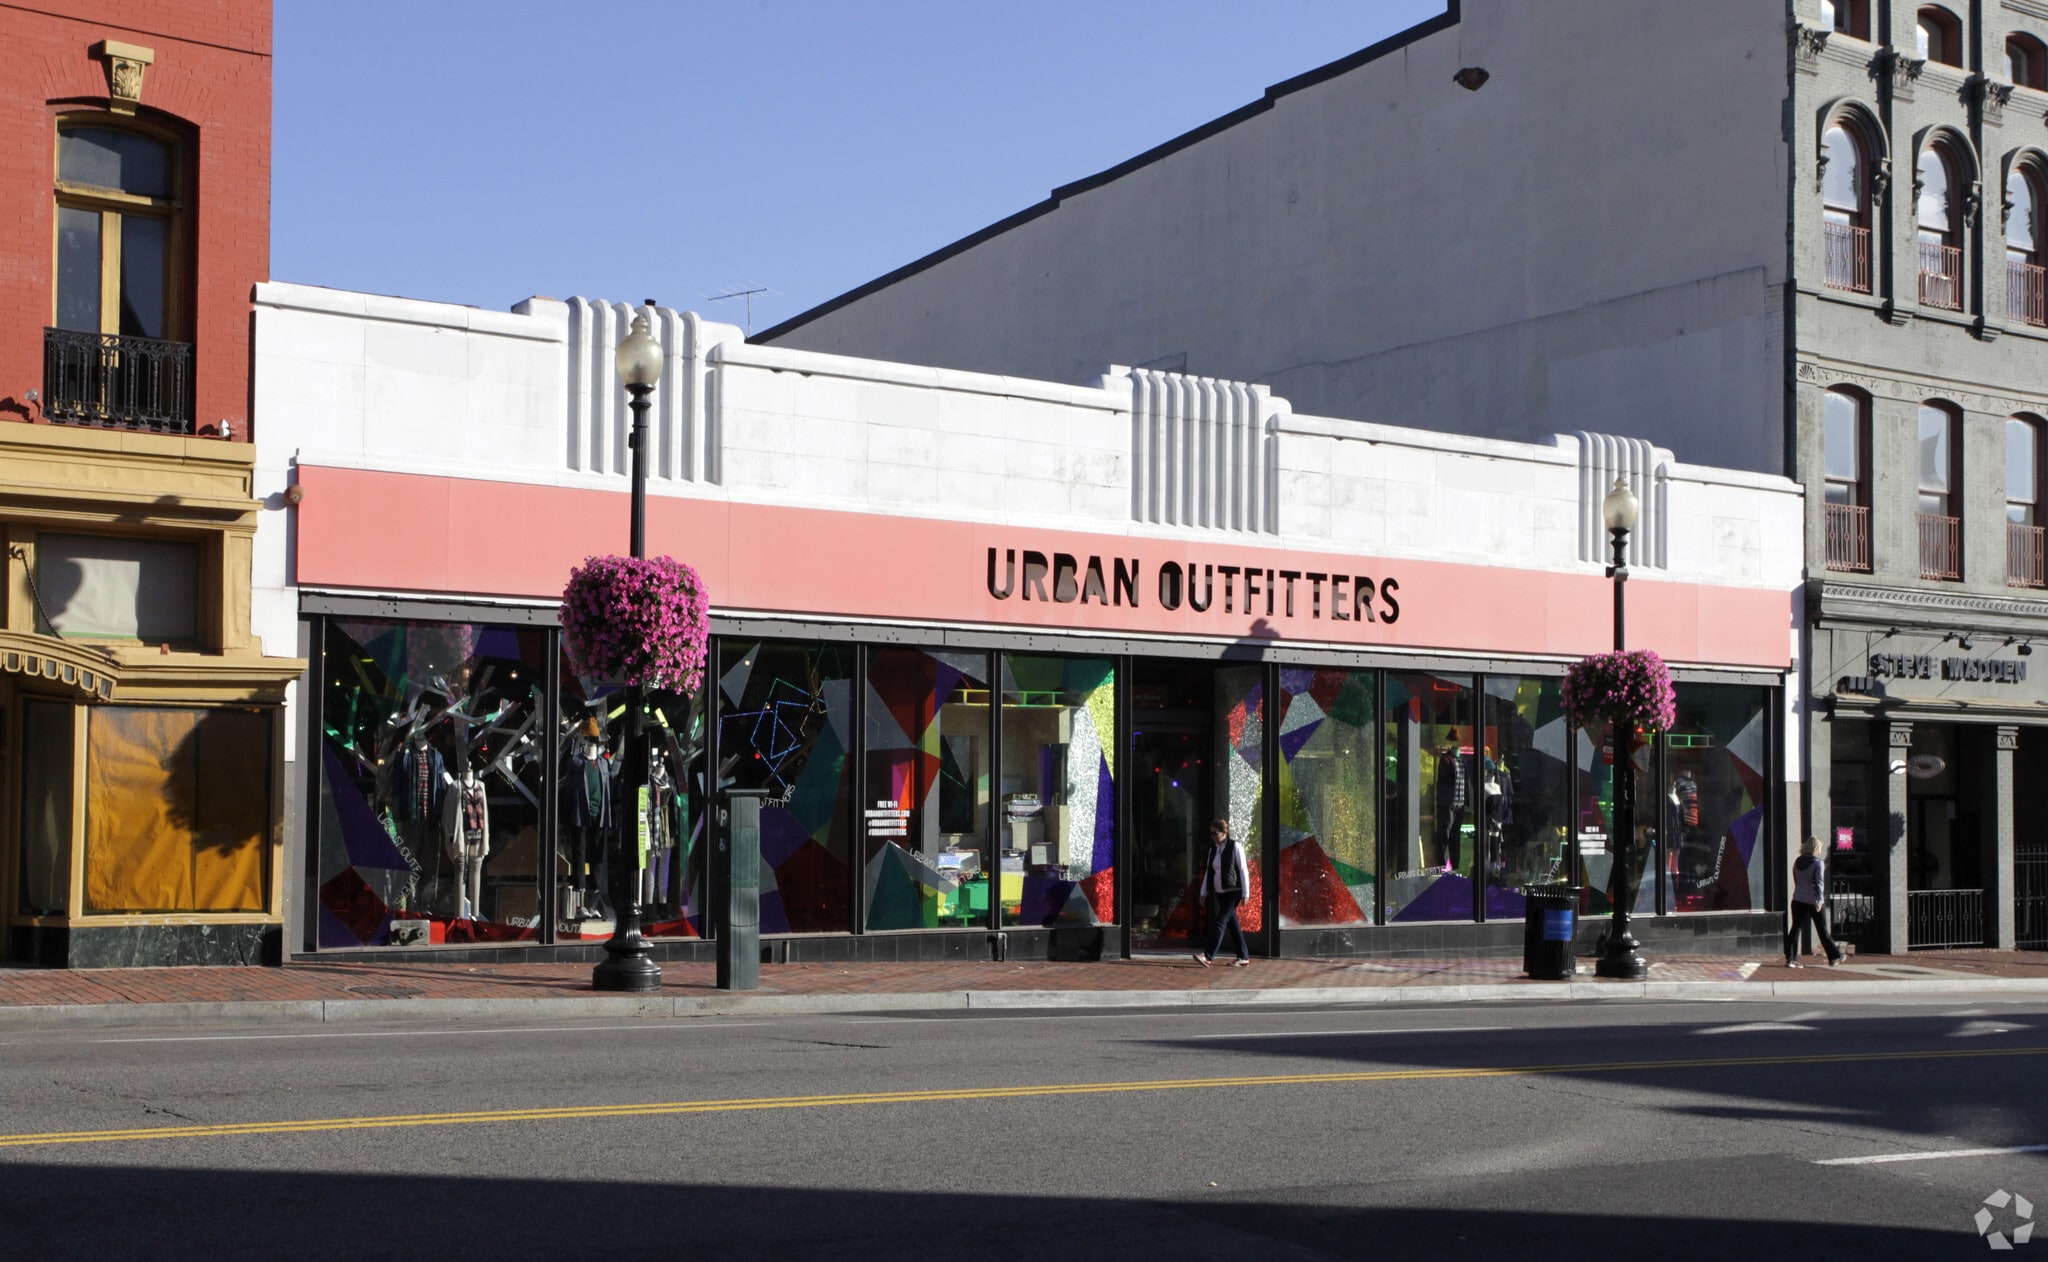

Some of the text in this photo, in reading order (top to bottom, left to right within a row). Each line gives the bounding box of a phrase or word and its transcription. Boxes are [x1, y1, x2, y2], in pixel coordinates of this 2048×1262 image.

[987, 547, 1400, 625] URBAN OUTFITTERS
[1871, 653, 2027, 684] STEVE MADDEN
